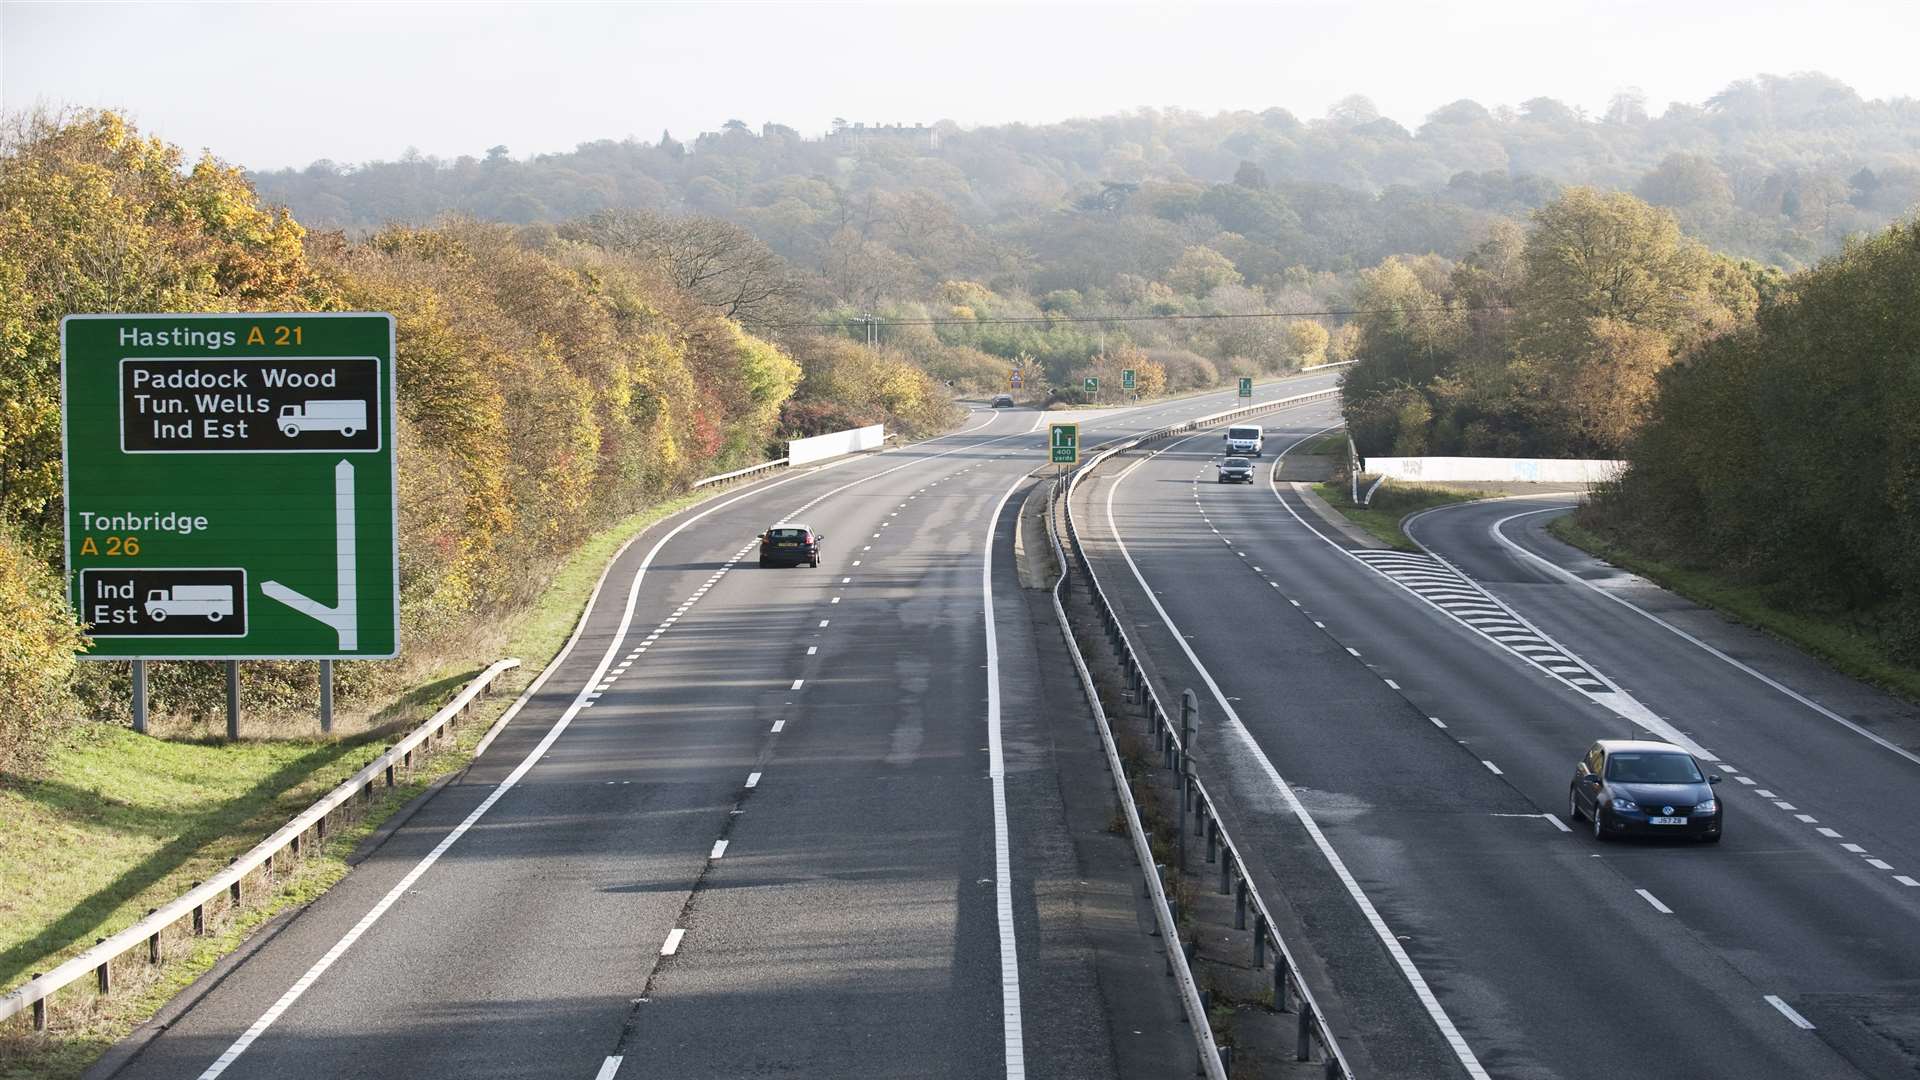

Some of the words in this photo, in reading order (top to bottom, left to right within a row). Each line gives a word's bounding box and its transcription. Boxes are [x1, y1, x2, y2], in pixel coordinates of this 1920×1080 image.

[119, 327, 236, 349] Hastings
[247, 326, 265, 346] A
[274, 326, 303, 345] 21
[133, 369, 248, 389] Paddock
[261, 368, 336, 388] Wood
[134, 395, 189, 414] Tun.
[195, 394, 270, 414] Wells
[153, 419, 193, 439] Ind
[203, 419, 249, 439] Est
[79, 511, 209, 535] Tonbridge
[80, 537, 98, 556] A
[106, 537, 140, 556] 26
[97, 580, 135, 599] Ind
[95, 606, 138, 624] Est
